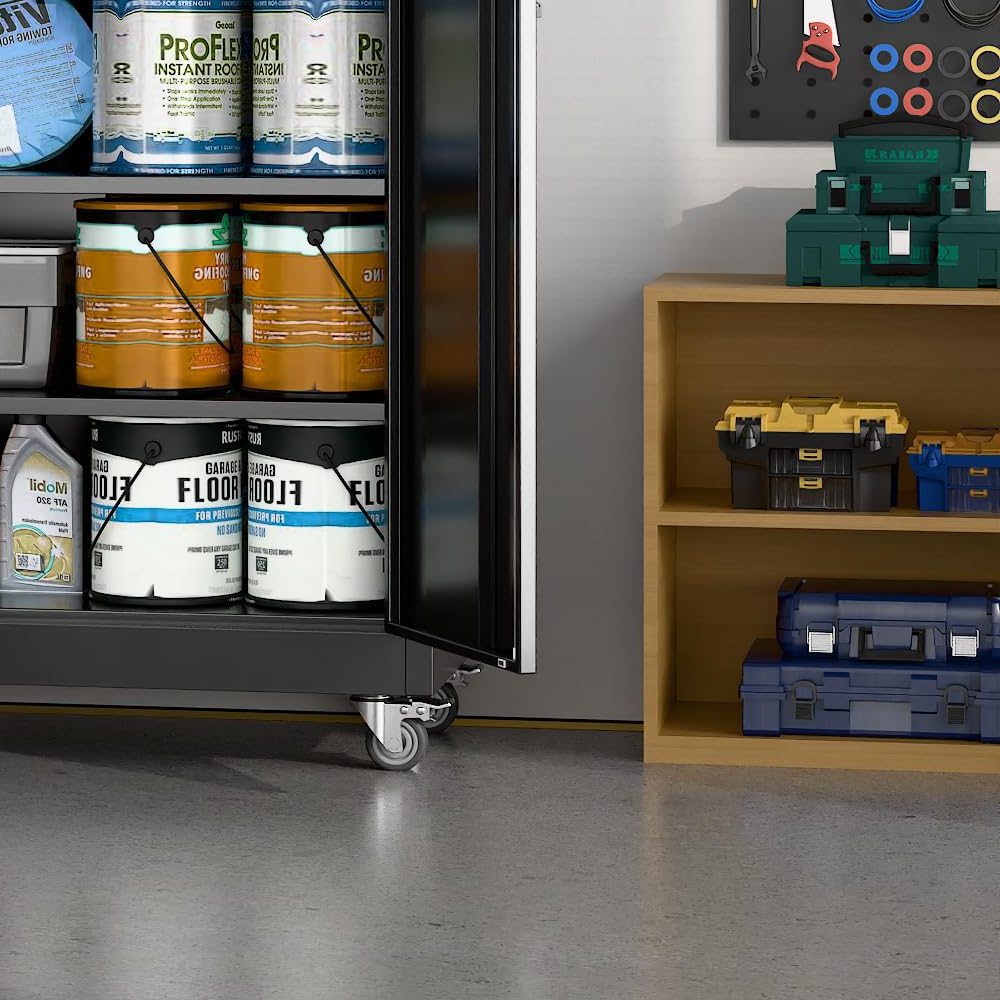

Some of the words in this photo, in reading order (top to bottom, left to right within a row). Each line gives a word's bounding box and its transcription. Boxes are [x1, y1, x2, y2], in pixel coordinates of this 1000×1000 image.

[154, 63, 212, 75] INSTANT
[205, 461, 238, 475] GARAGE
[177, 475, 239, 503] FLOOR
[195, 510, 210, 521] FOR
